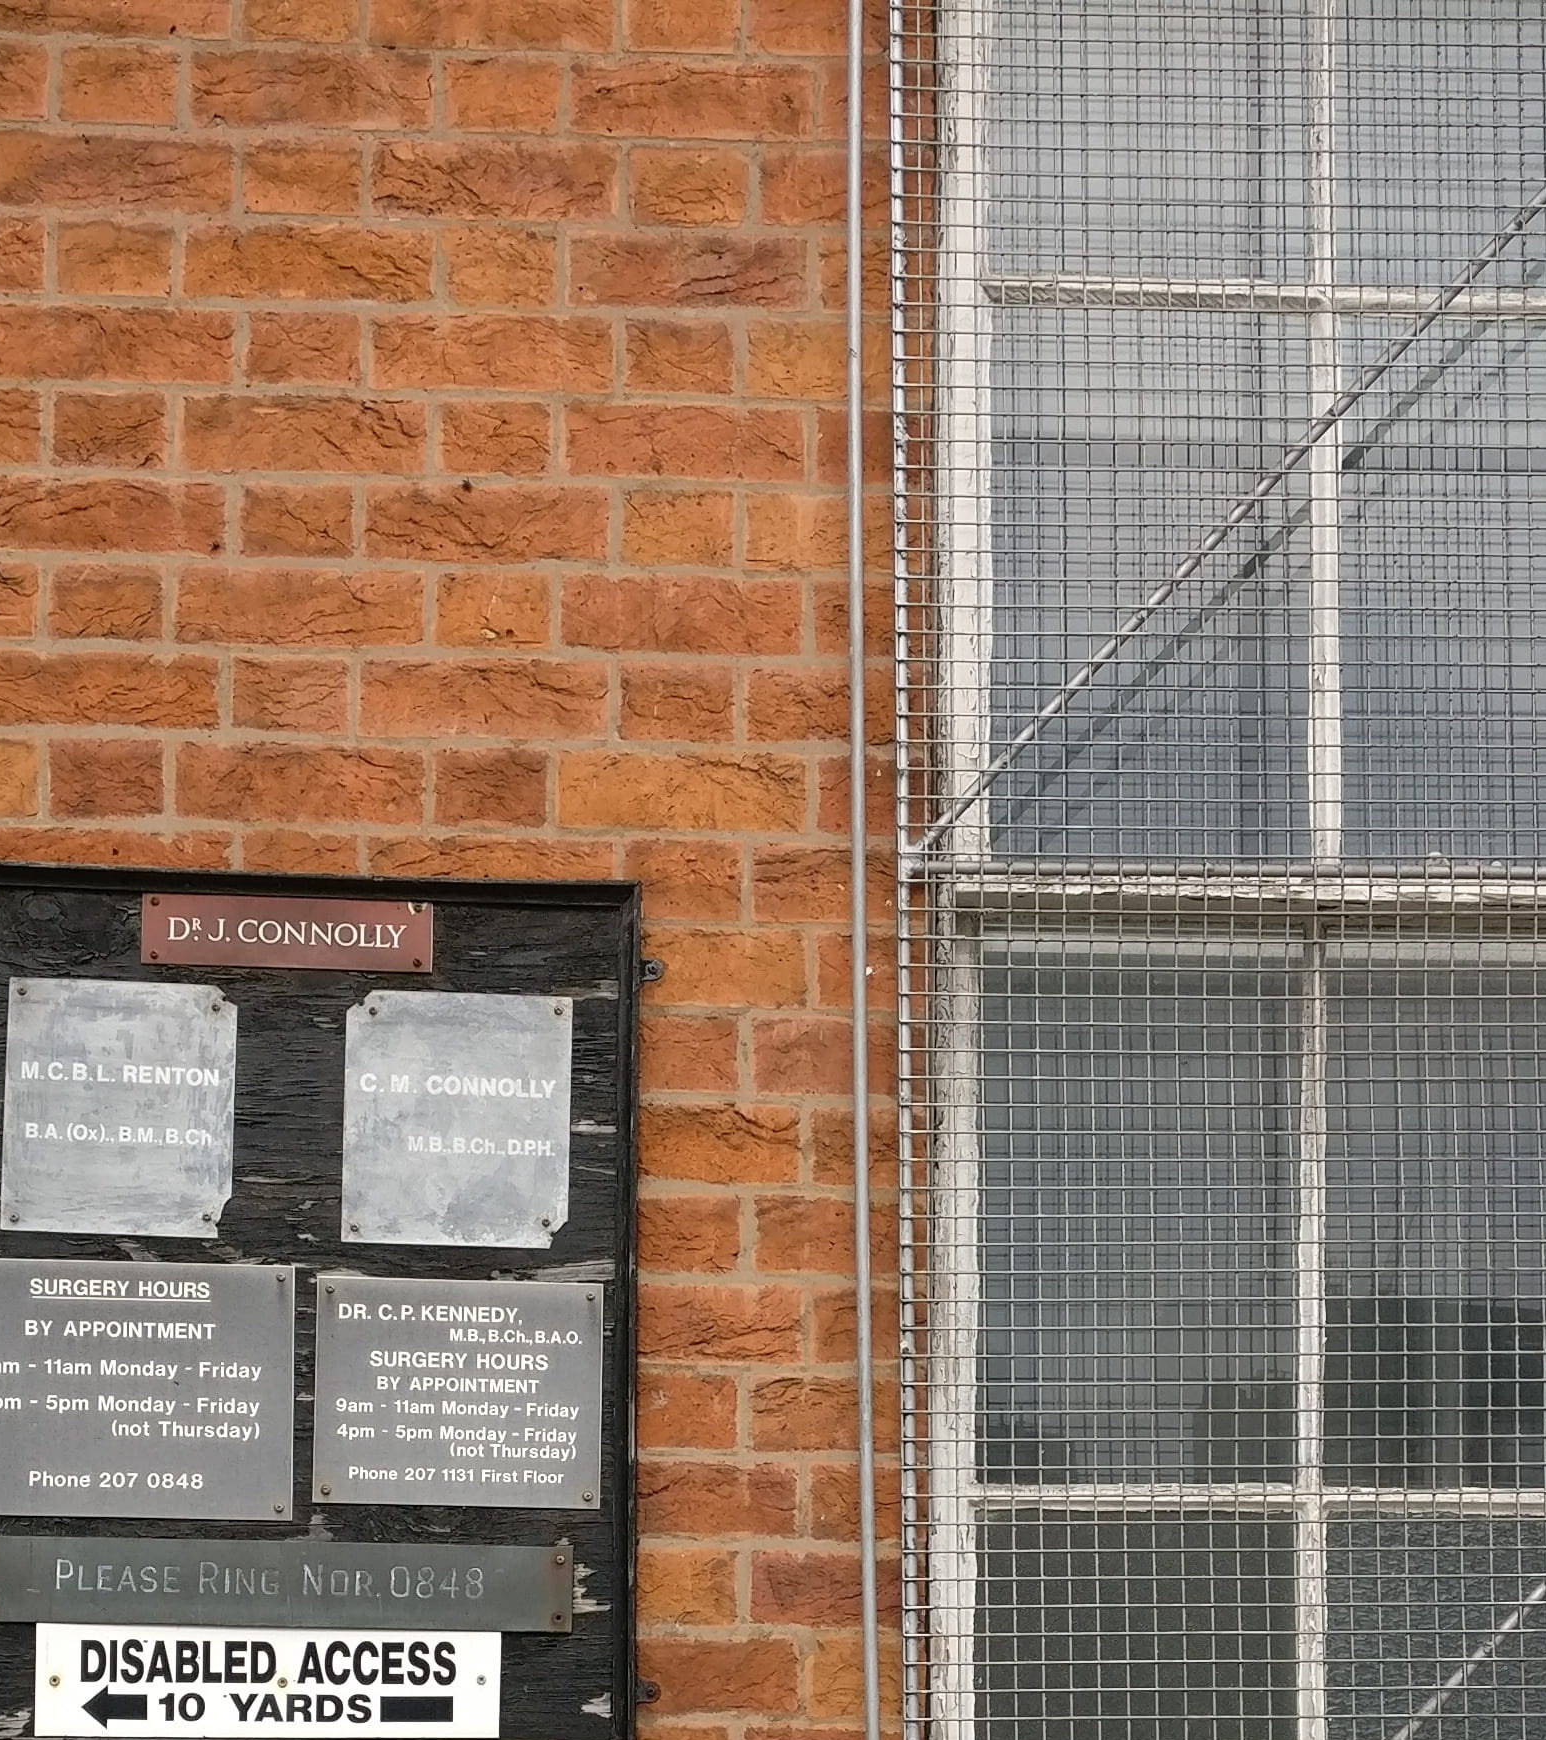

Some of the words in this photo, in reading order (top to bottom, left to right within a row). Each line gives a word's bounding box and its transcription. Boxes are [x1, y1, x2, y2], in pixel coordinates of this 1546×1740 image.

[207, 918, 231, 942] J.
[237, 919, 407, 948] CONNOLLY
[122, 1064, 220, 1087] RENTON
[426, 1075, 557, 1099] CONNOLLY
[29, 1277, 130, 1296] SURGERY
[138, 1280, 210, 1299] HOURS
[338, 1303, 372, 1319] DR.
[421, 1305, 523, 1326] KENNEDY,
[24, 1319, 53, 1336] BY
[63, 1320, 216, 1340] APPOINTMENT
[43, 1358, 92, 1375] 11am
[99, 1359, 178, 1382] Monday
[198, 1361, 262, 1381] Friday
[369, 1350, 468, 1369] SURGERY
[476, 1353, 549, 1371] HOURS
[377, 1376, 401, 1390] BY
[409, 1376, 539, 1394] APPOINTMENT
[45, 1394, 89, 1415] 5pm
[98, 1395, 176, 1416] Monday
[197, 1397, 260, 1417] Friday
[335, 1398, 374, 1413] 9am
[394, 1399, 435, 1415] 11am
[441, 1400, 509, 1418] Monday
[526, 1402, 580, 1420] Friday
[111, 1420, 150, 1438] (not
[158, 1421, 260, 1441] Thursday)
[336, 1423, 375, 1441] 4pm
[395, 1425, 433, 1442] 5pm
[439, 1426, 507, 1443] Monday
[524, 1428, 577, 1445] Friday
[449, 1442, 484, 1458] (not
[490, 1443, 577, 1461] Thursday)
[28, 1470, 91, 1488] Phone
[99, 1473, 138, 1488] 207
[147, 1473, 204, 1489] 0848
[348, 1466, 398, 1481] Phone
[404, 1467, 436, 1482] 207
[441, 1468, 475, 1483] 1131
[481, 1469, 518, 1483] First
[523, 1470, 565, 1484] Floor
[55, 1557, 181, 1594] PLEASE
[198, 1561, 280, 1597] RING
[389, 1565, 485, 1600] 0848
[80, 1639, 278, 1684] DISABLED
[297, 1640, 457, 1686] ACCESS
[158, 1693, 205, 1722] 10
[229, 1693, 373, 1723] YARDS
